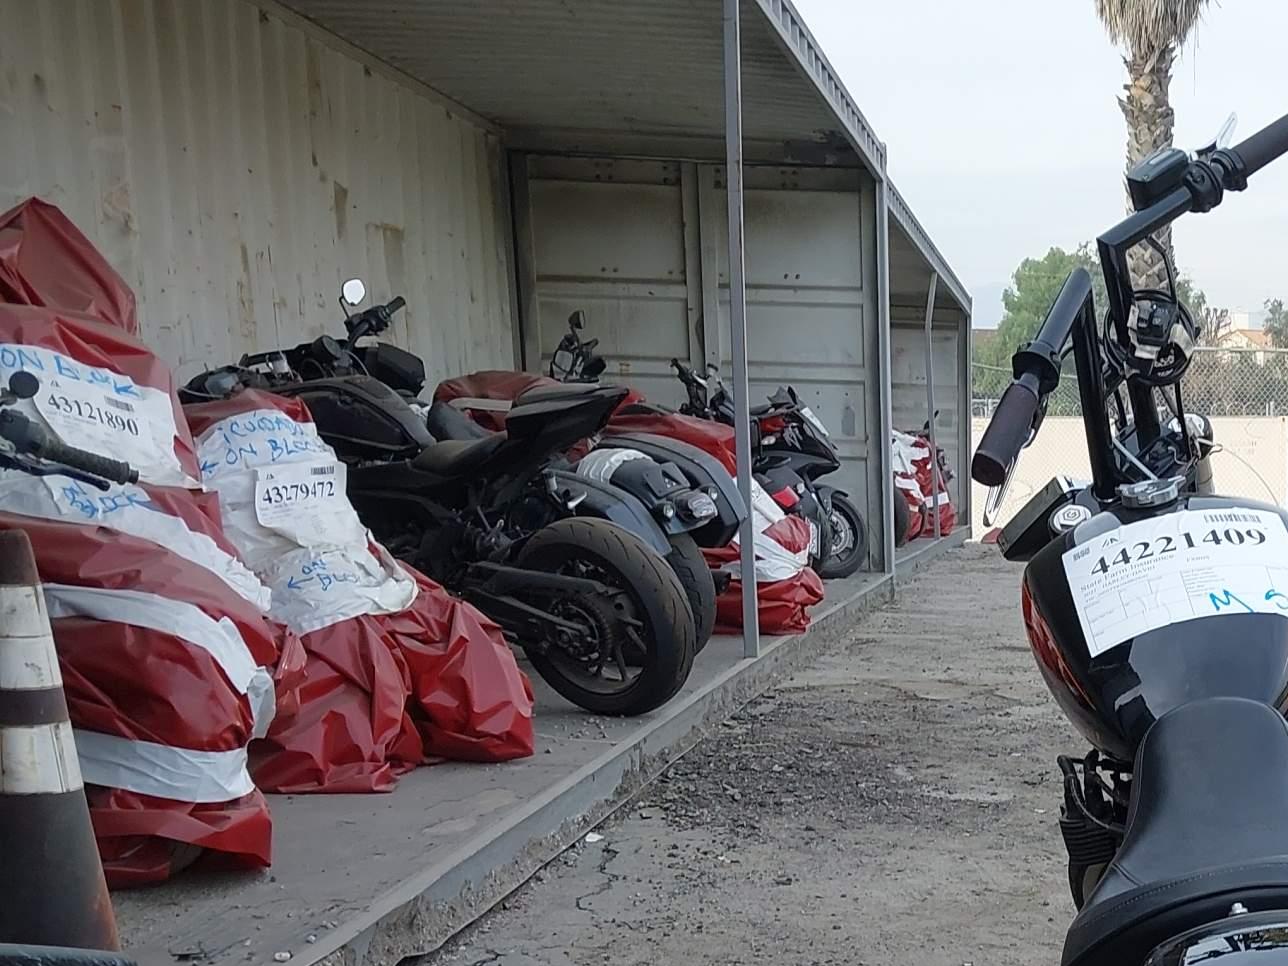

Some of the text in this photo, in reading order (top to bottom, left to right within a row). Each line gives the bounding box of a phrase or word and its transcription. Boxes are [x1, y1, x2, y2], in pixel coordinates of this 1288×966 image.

[47, 393, 140, 437] 43121890
[225, 443, 257, 465] ON
[262, 480, 335, 505] 43279472
[1090, 527, 1266, 576] 44221409
